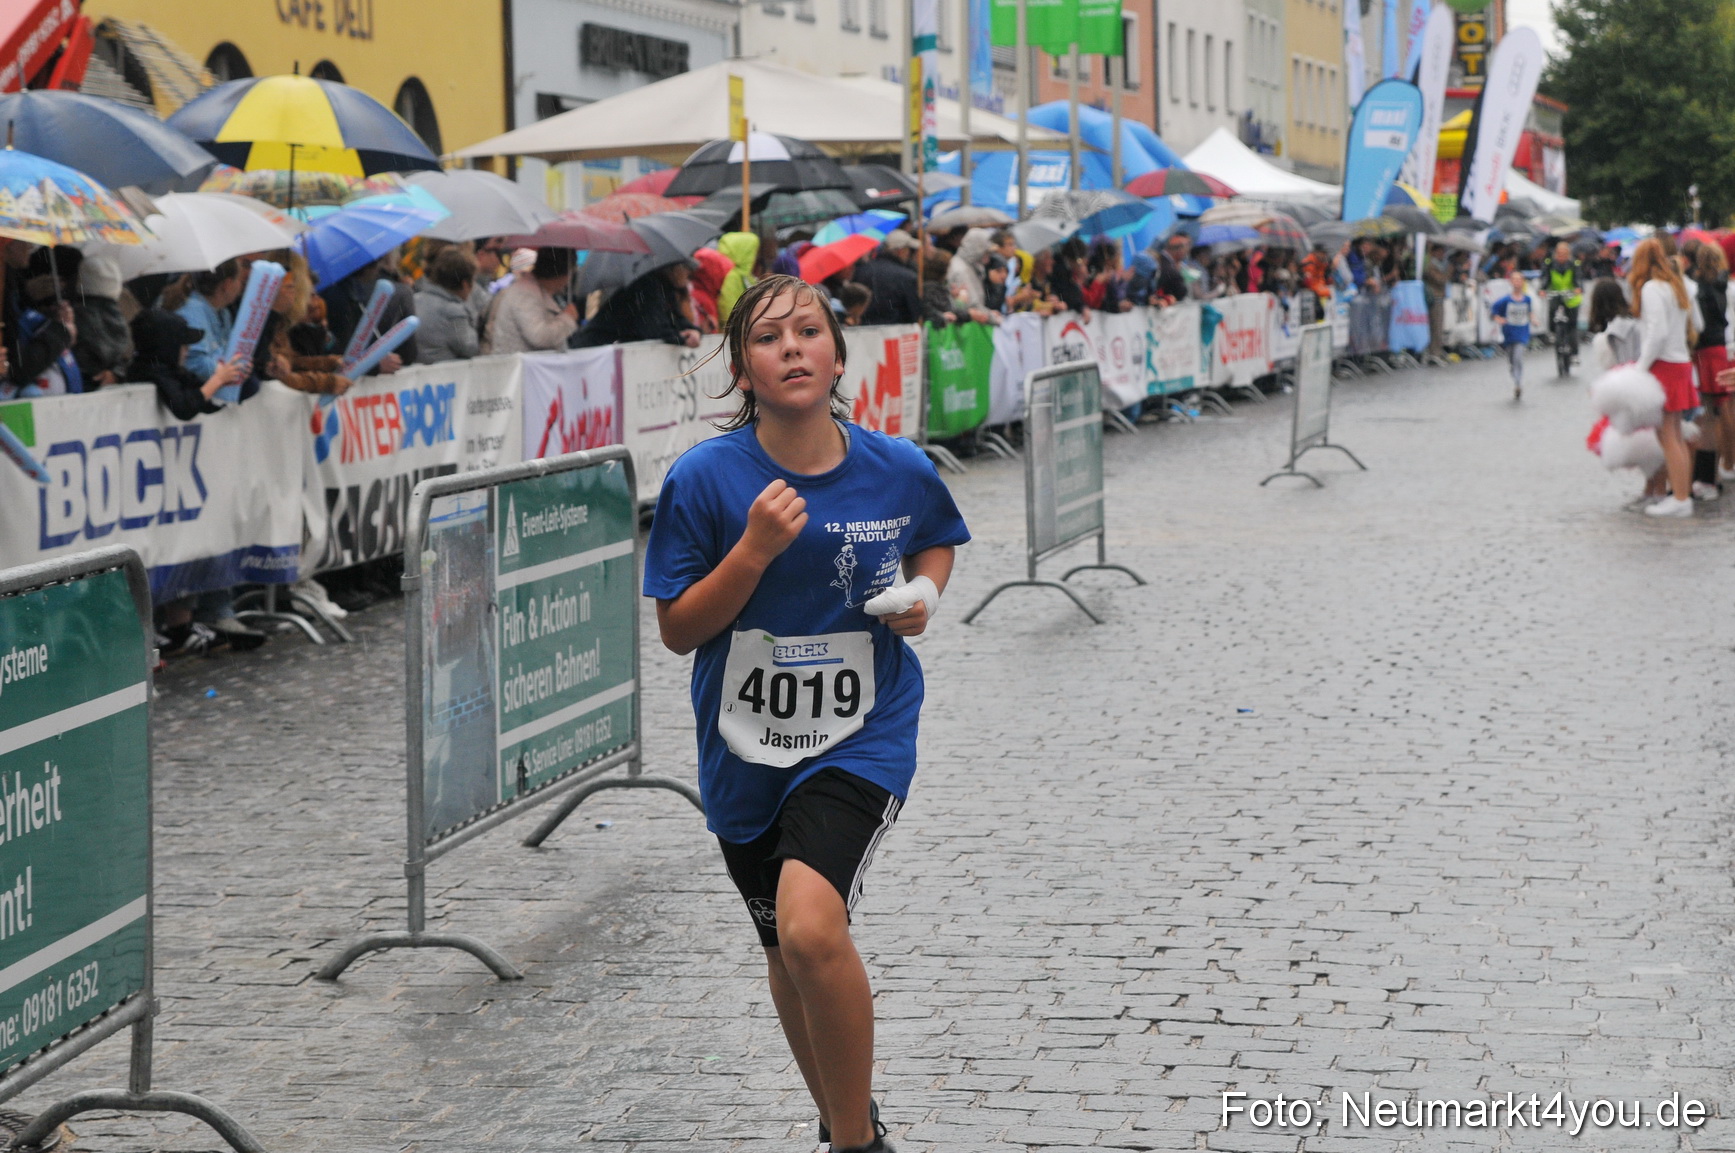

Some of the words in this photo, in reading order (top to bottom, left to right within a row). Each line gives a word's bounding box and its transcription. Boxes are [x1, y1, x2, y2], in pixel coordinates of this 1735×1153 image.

[334, 0, 374, 40] DELI
[337, 383, 456, 464] INTERSPORT
[39, 423, 208, 550] BOCK
[522, 503, 588, 538] Event-Leit-Systeme
[824, 522, 845, 533] 12.
[845, 515, 911, 532] NEUMARKTER
[844, 528, 901, 543] STADTLAUF
[503, 605, 525, 649] Fun
[527, 597, 539, 640] &
[540, 587, 577, 637] Action
[579, 580, 590, 622] in
[772, 642, 829, 659] BOCK
[503, 662, 553, 713] sicheren
[555, 637, 600, 692] Bahnen!
[738, 667, 861, 719] 4019
[532, 740, 559, 775] Service
[759, 727, 829, 750] Jasmin
[22, 977, 63, 1037] 09181
[66, 960, 99, 1012] 6352
